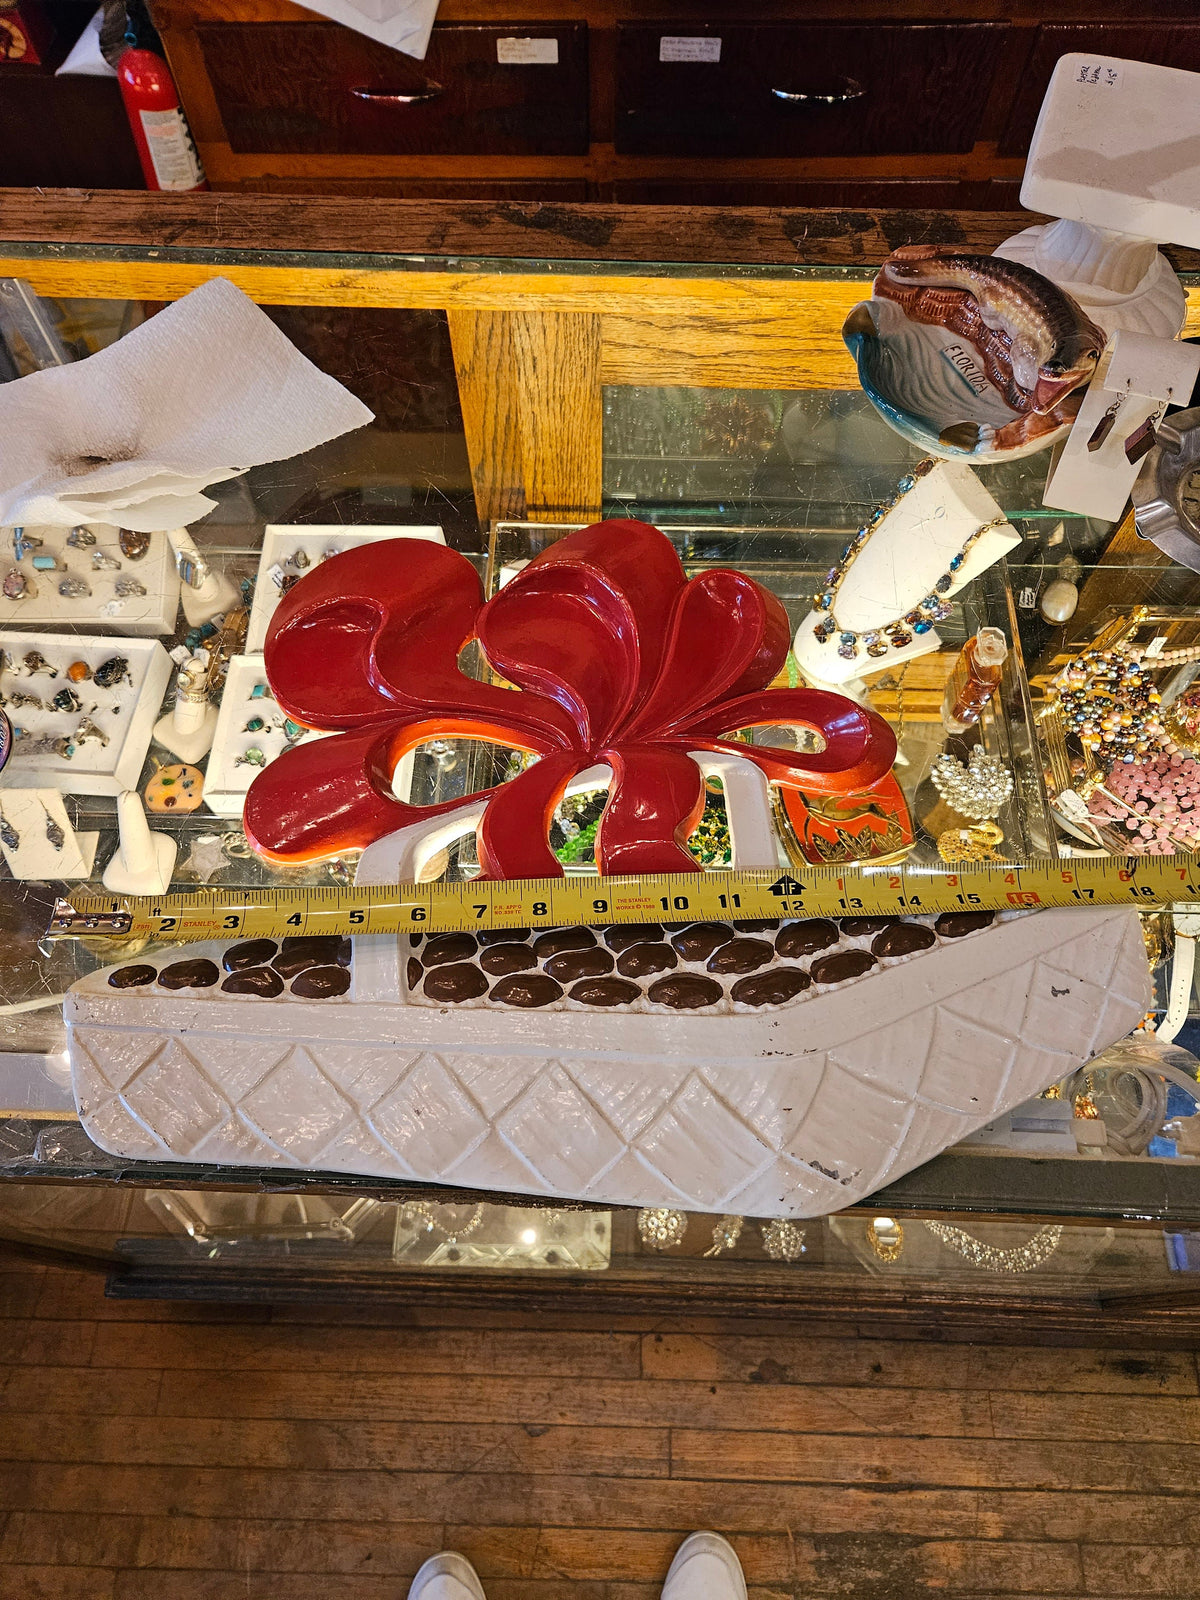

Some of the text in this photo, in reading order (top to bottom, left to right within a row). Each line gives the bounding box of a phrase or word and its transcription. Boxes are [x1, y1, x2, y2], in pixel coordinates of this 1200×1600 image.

[944, 345, 989, 394] FLORIDA
[837, 868, 1187, 890] 1 2 3 4 5 6 7
[780, 882, 797, 895] 1F
[111, 884, 1200, 931] 1 2 3 4 5 6 7 8 9 10 11 12 13 14 15 16 17 18 1
[152, 907, 162, 917] ft
[184, 920, 217, 928] STANLEY
